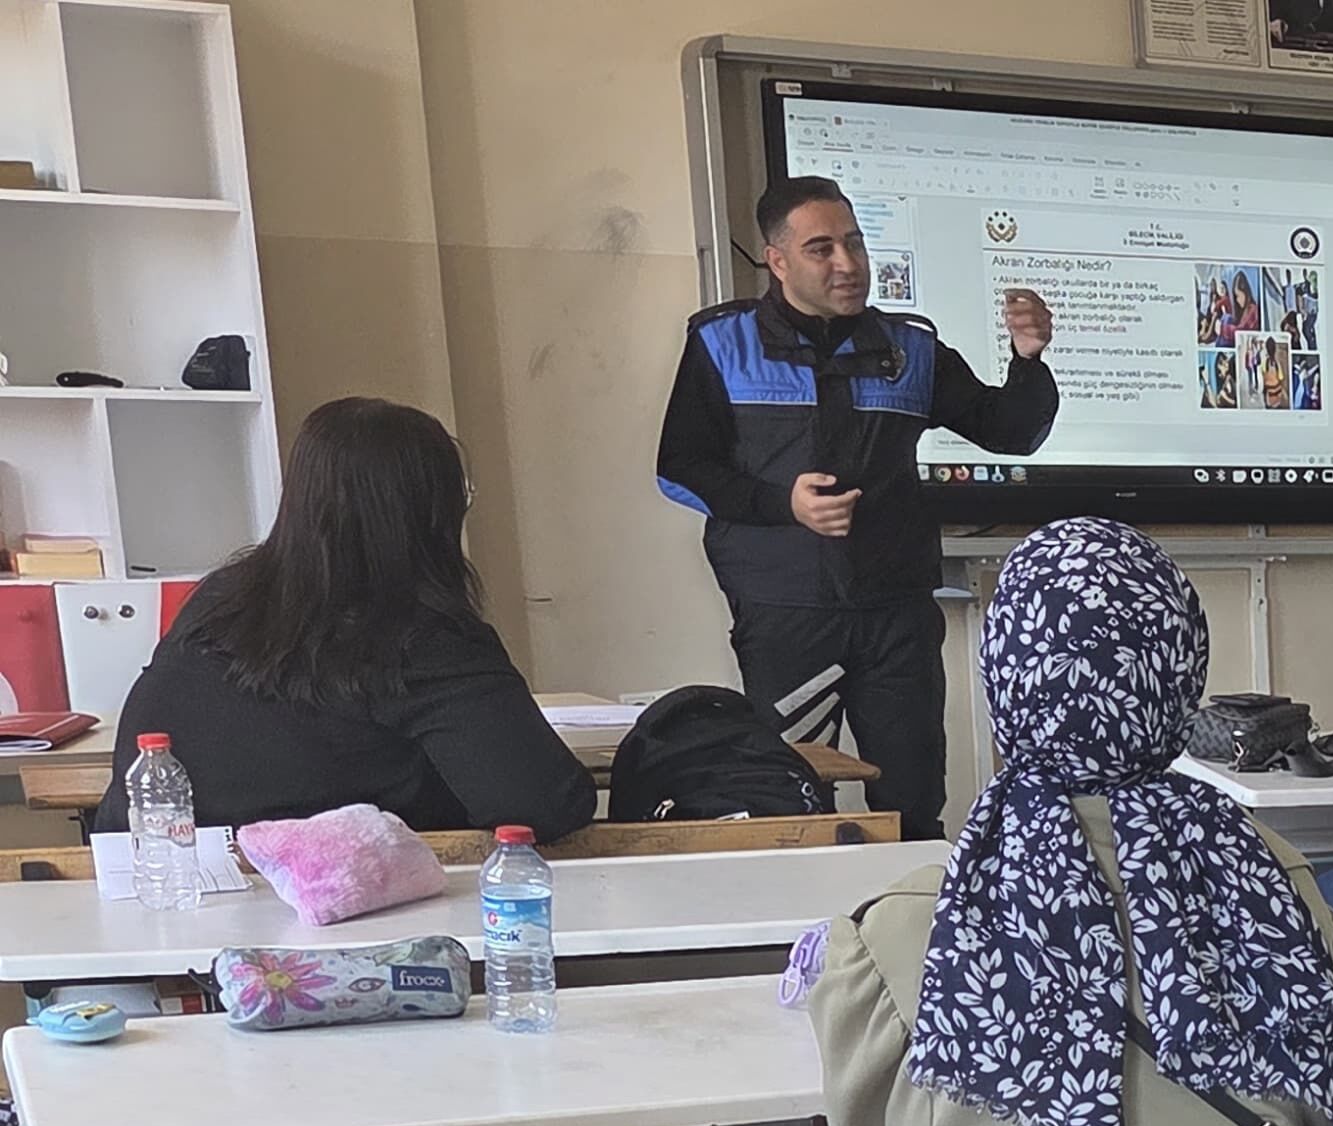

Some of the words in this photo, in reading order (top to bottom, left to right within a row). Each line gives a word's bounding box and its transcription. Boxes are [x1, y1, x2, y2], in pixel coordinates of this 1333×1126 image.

[992, 256, 1025, 268] Akran
[1027, 257, 1074, 272] Zorbalığı
[1076, 260, 1112, 272] Nedir?
